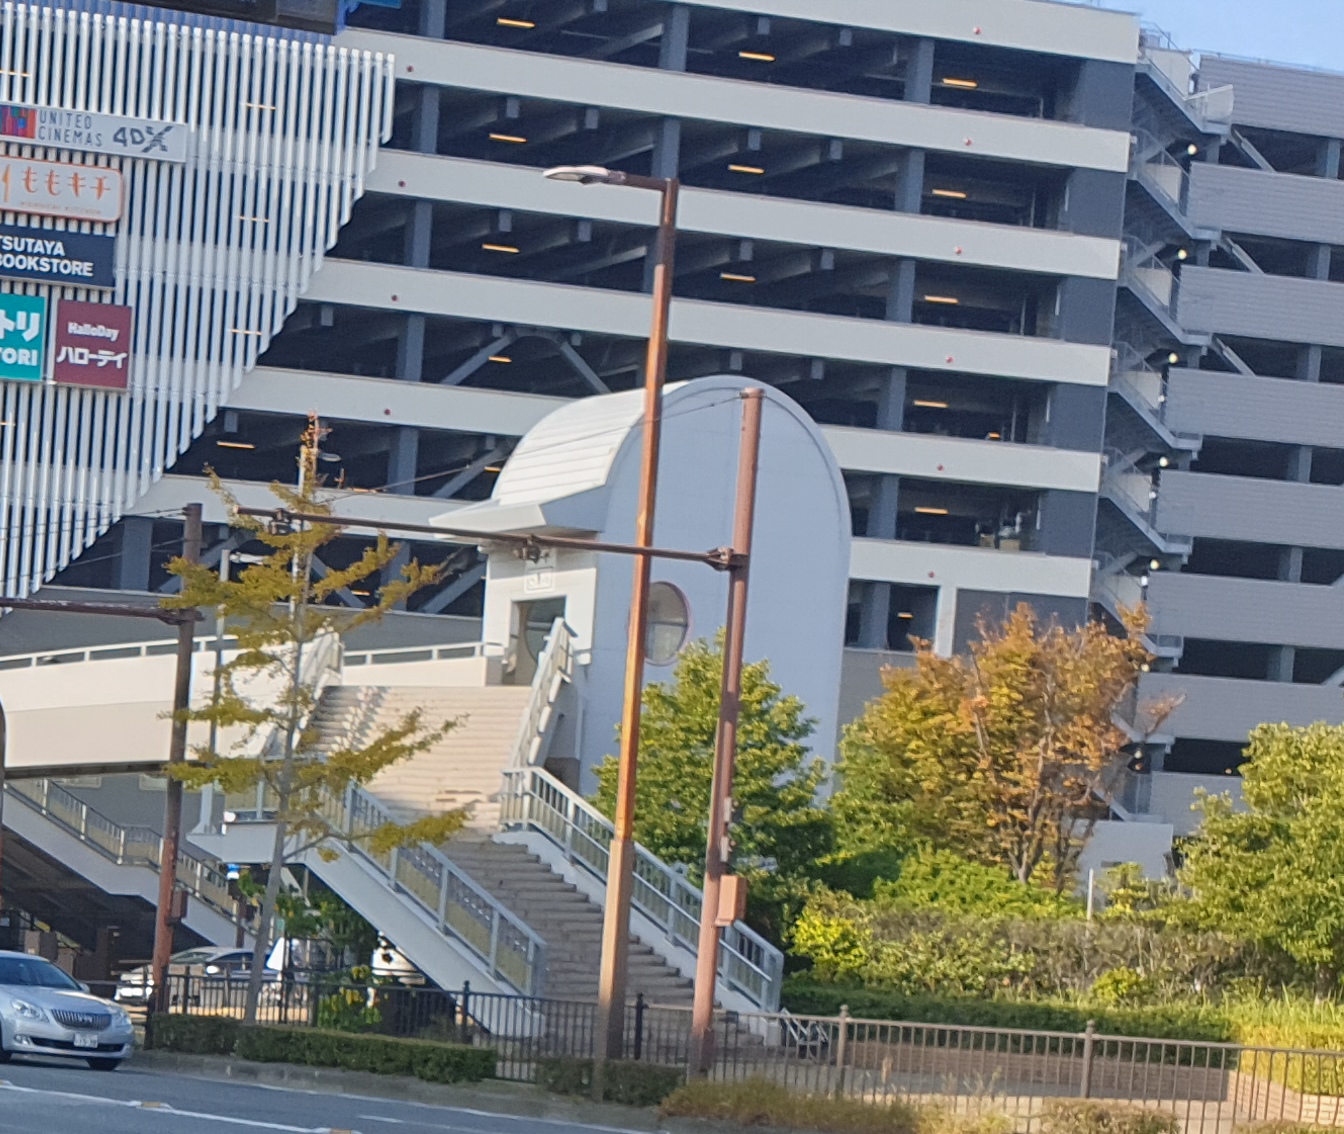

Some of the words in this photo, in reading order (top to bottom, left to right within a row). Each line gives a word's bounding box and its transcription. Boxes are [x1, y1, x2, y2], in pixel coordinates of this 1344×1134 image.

[38, 108, 92, 130] UNITED
[37, 126, 103, 148] CINEMAS
[22, 166, 111, 200] ももキチ
[56, 346, 128, 369] ハローデイ
